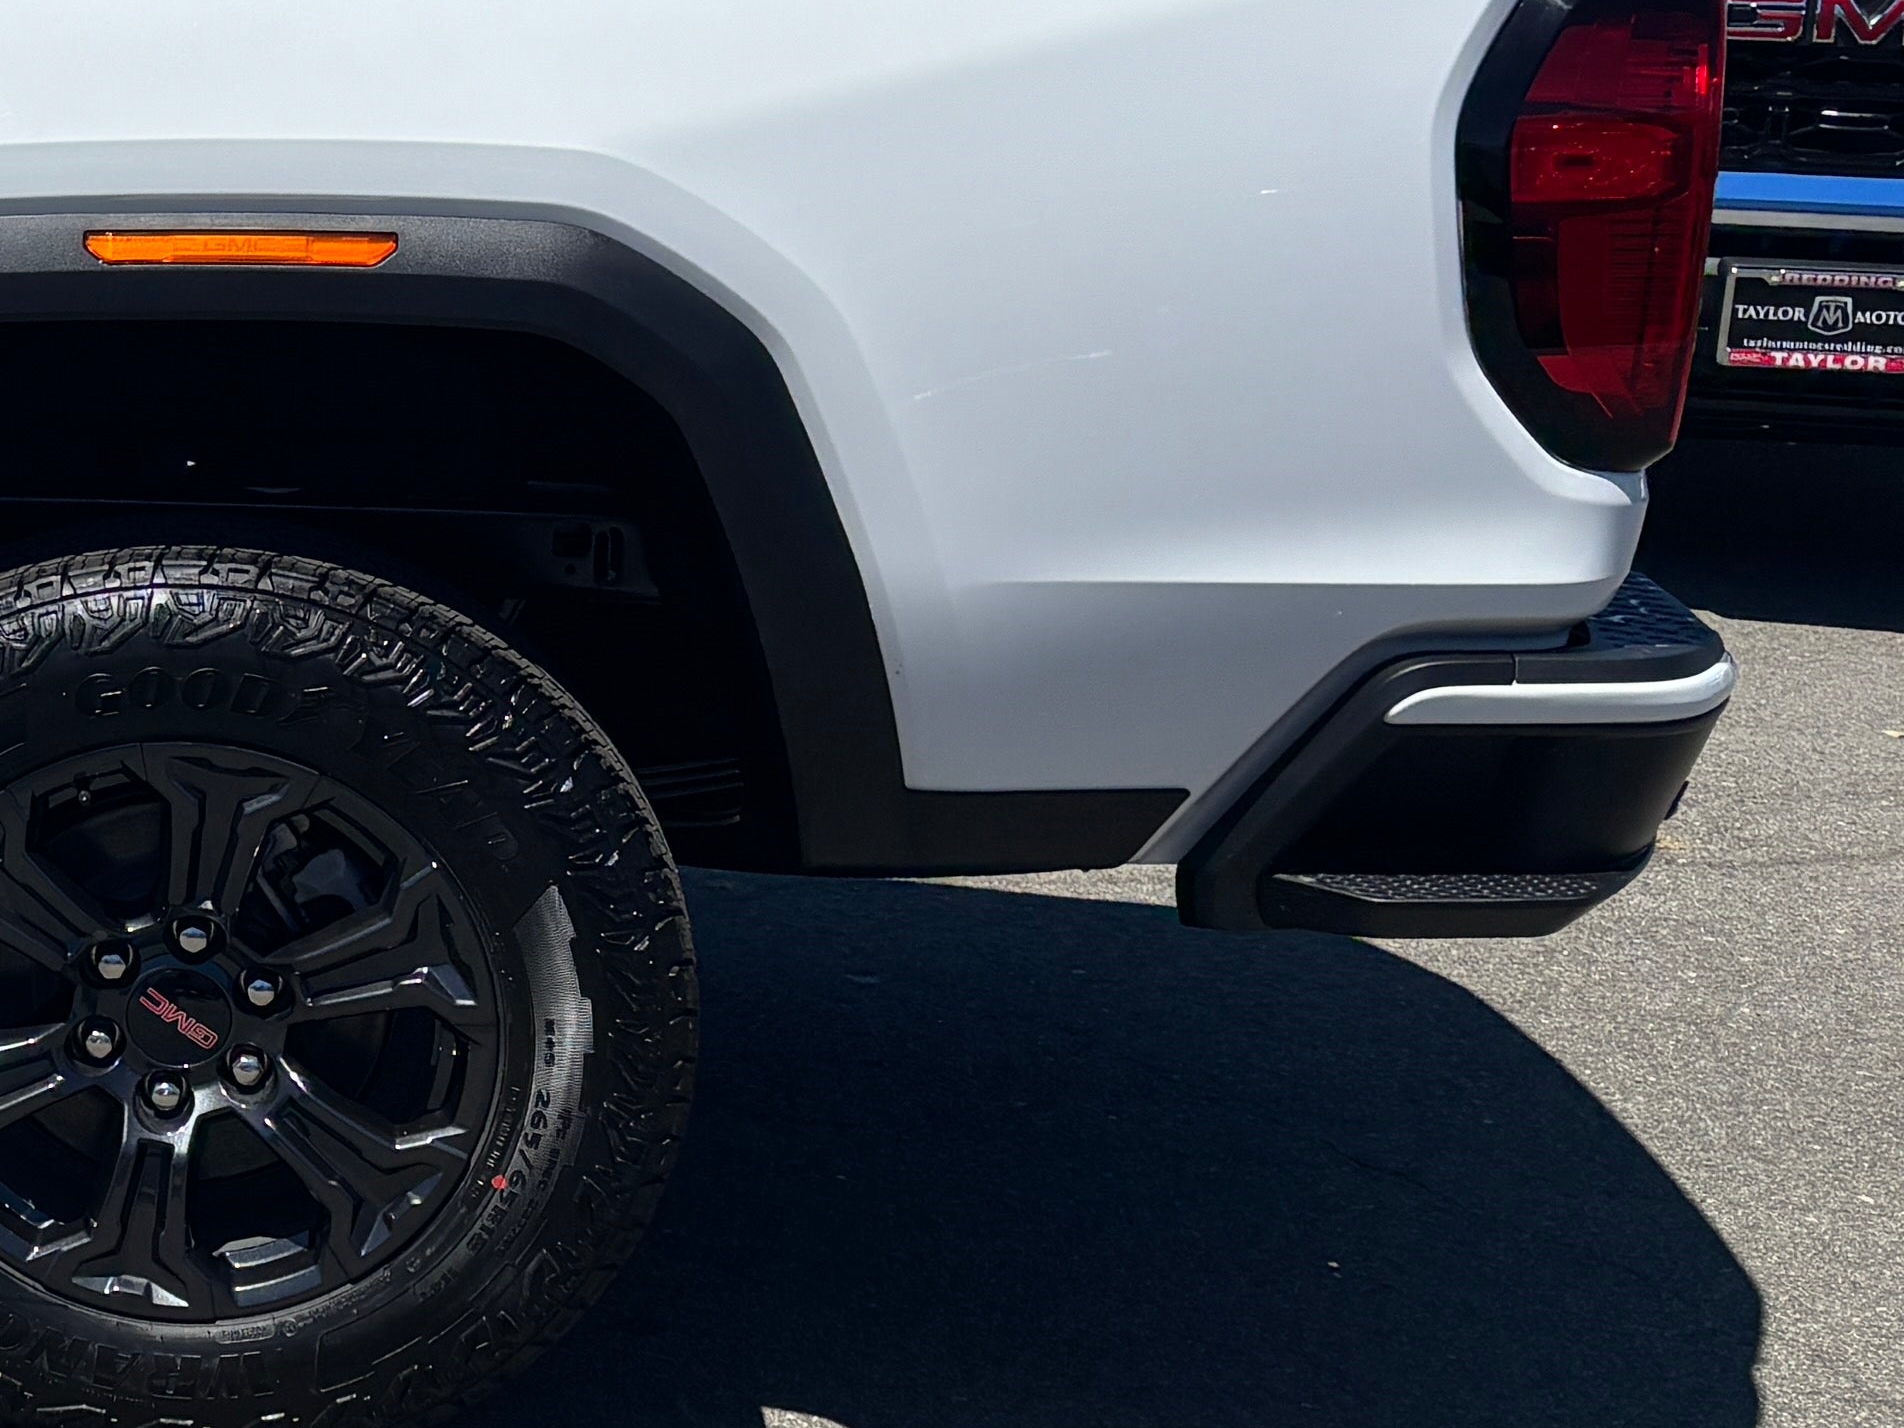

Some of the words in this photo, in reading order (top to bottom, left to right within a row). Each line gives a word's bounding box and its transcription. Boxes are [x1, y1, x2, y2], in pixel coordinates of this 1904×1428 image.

[1783, 273, 1895, 289] REDDING
[1735, 304, 1807, 322] TAYLOR
[1770, 351, 1888, 372] TAYLOR
[138, 986, 220, 1051] GMC
[464, 1087, 554, 1260] 265/65R18
